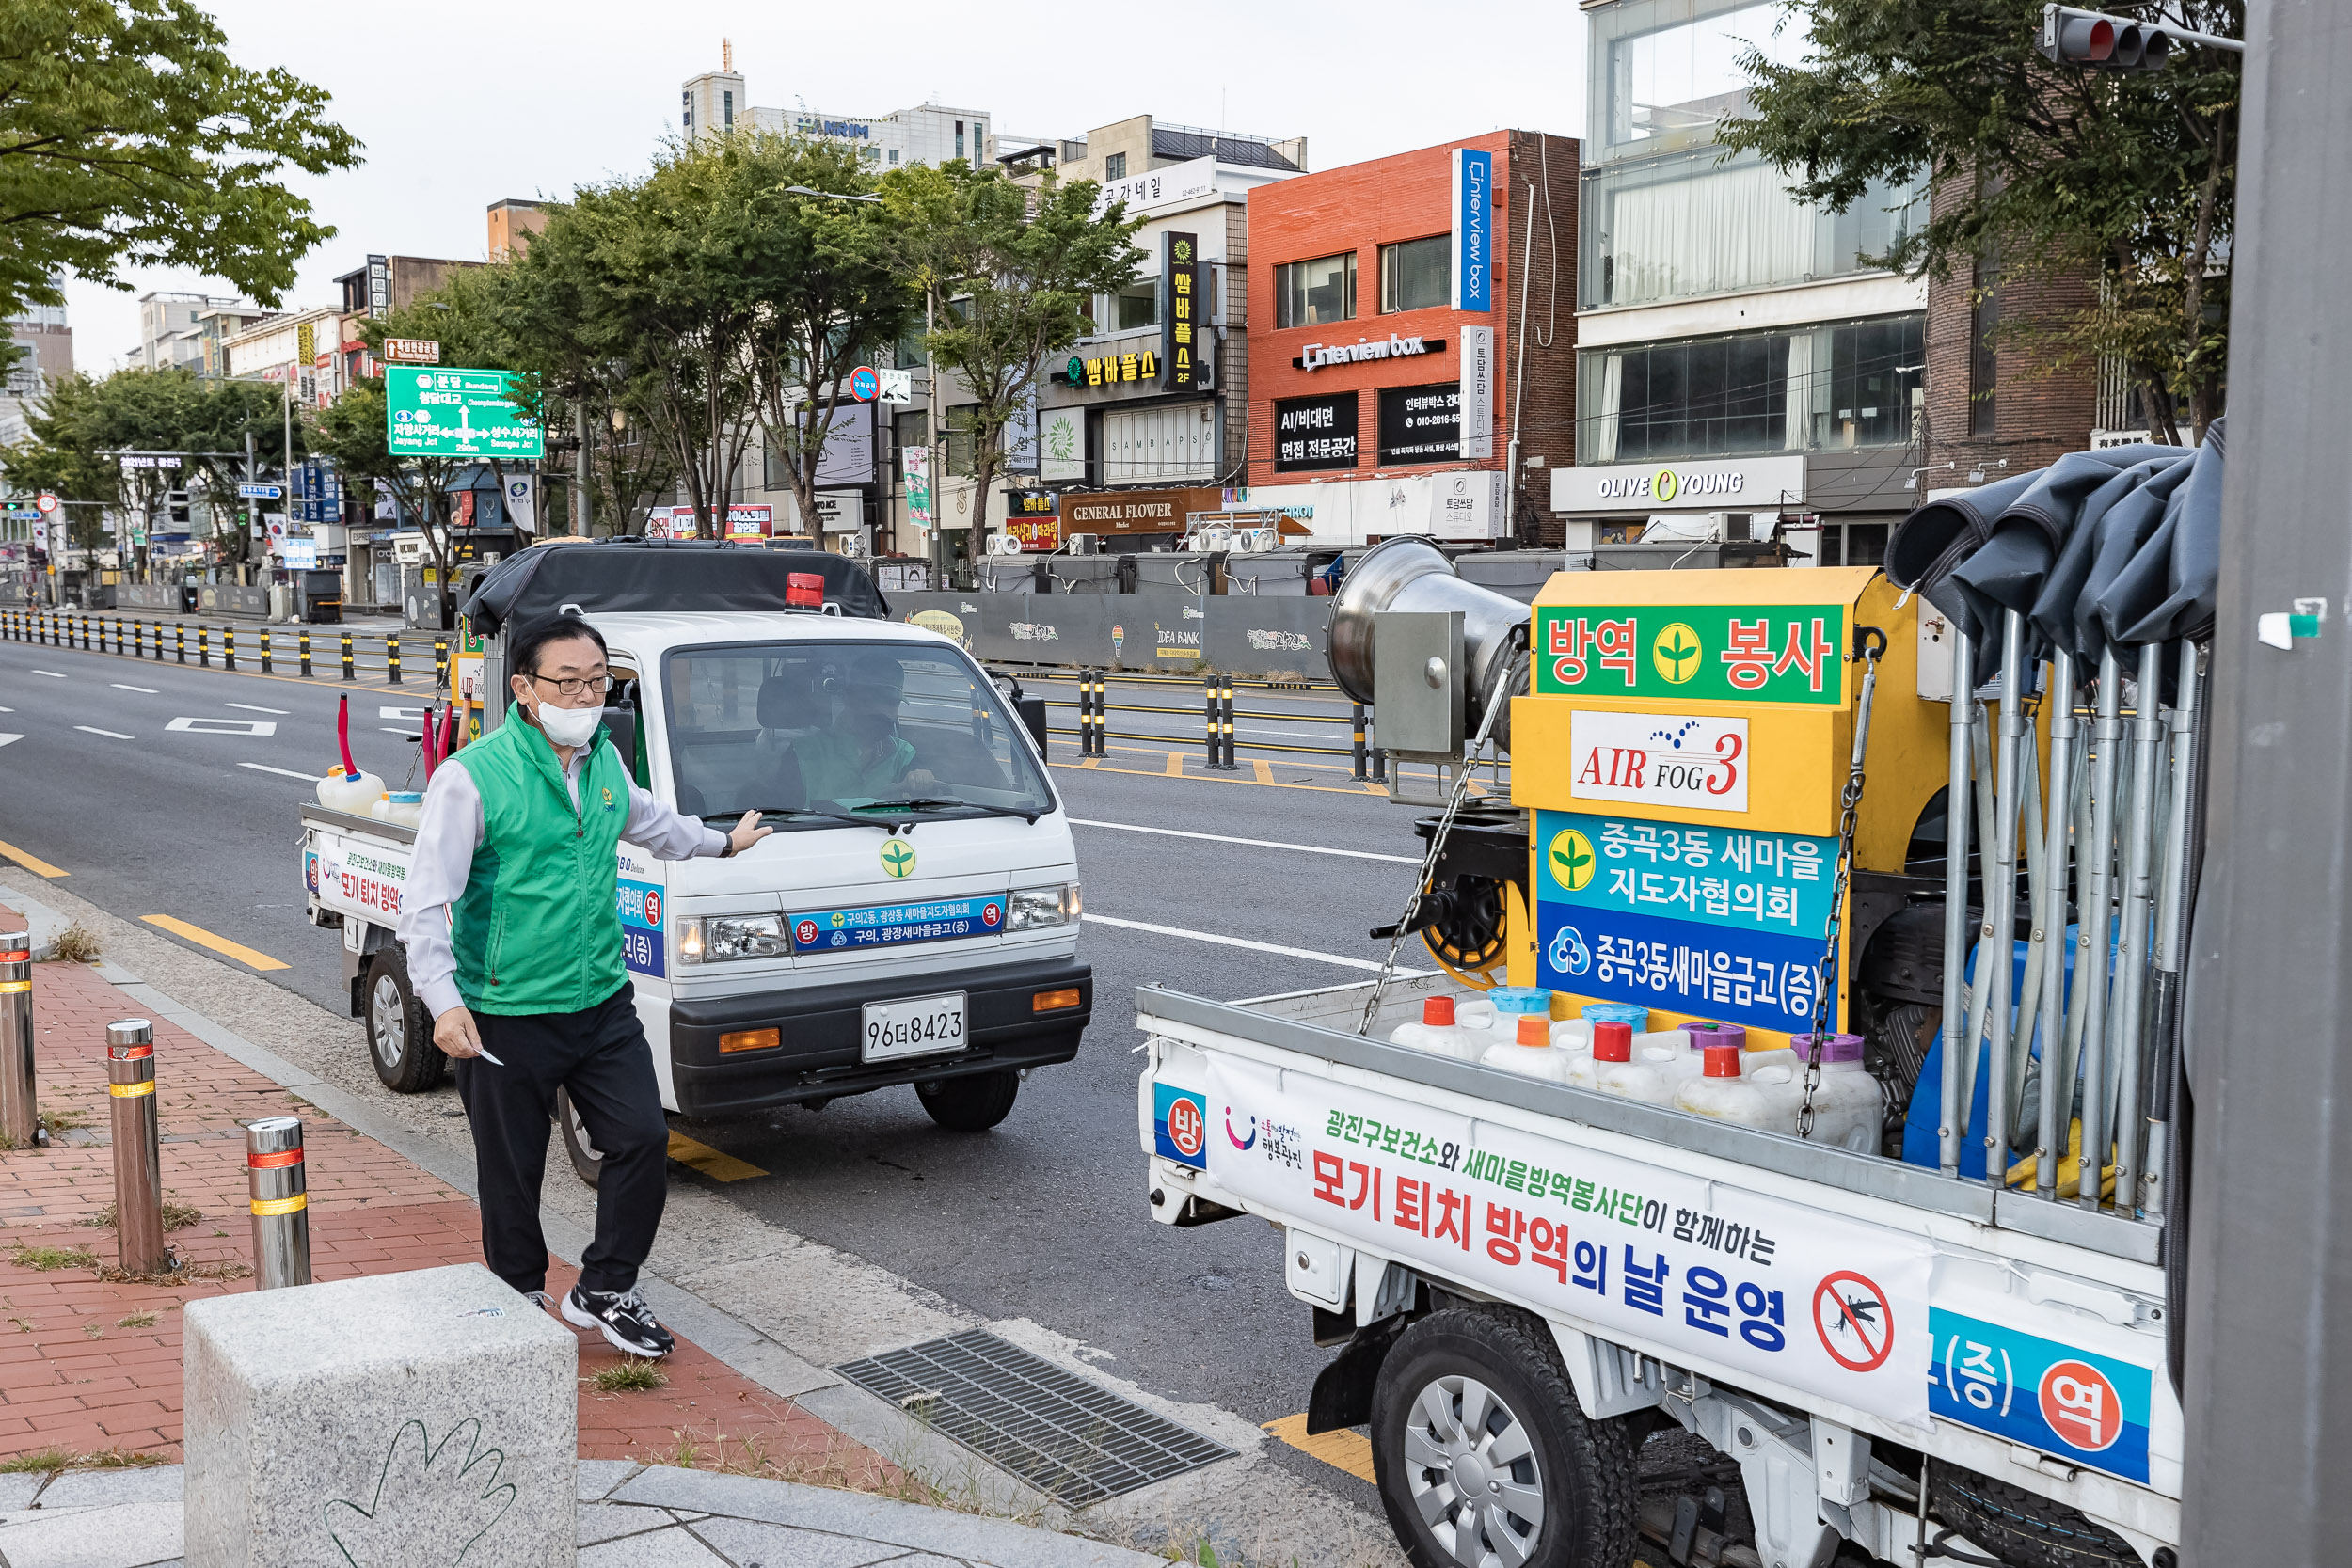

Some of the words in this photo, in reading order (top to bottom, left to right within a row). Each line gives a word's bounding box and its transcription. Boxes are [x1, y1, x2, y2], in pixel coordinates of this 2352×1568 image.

[798, 118, 868, 139] HANRIM
[1470, 173, 1484, 261] interview
[1470, 265, 1484, 300] box
[1175, 273, 1192, 369] 쌈바플스
[1304, 337, 1390, 371] interview
[1391, 333, 1426, 357] box
[1087, 351, 1155, 386] 쌈바플스
[1177, 373, 1190, 383] 2F
[437, 375, 461, 388] 분당
[465, 382, 499, 391] Bundang
[419, 391, 462, 405] 청담대교
[1406, 395, 1445, 411] 인터뷰박스
[393, 423, 440, 436] 자양사거리
[490, 426, 538, 439] 성수사거리
[1281, 407, 1334, 432] AI/비대면
[1476, 397, 1486, 442] 스튜디오
[393, 437, 423, 447] Jayang
[424, 437, 437, 446] Jct
[455, 444, 479, 452] 290m
[491, 439, 519, 450] Seongsu
[522, 440, 533, 449] Jct
[1281, 440, 1304, 462] 면접
[1308, 436, 1356, 458] 전문공간
[1598, 477, 1650, 498] OLIVE
[1678, 472, 1743, 494] YOUNG
[1073, 505, 1123, 521] GENERAL
[1126, 503, 1173, 519] FLOWER
[1446, 512, 1473, 522] 스튜디오
[1157, 630, 1175, 644] IDEA
[1177, 631, 1200, 645] BANK
[1548, 617, 1638, 688] 방역
[1720, 617, 1833, 694] 봉사
[1578, 746, 1647, 790] AIR
[1655, 764, 1704, 792] FOG
[1706, 733, 1743, 796] 3
[1600, 822, 1714, 869] 중곡3동
[1719, 833, 1824, 882] 새마을
[377, 861, 406, 881] 새마을방역봉
[631, 863, 645, 875] Deluxe
[342, 872, 358, 903] 모기
[361, 878, 379, 909] 퇴치
[1608, 868, 1799, 927] 지도자협의회
[647, 896, 659, 922] 역
[847, 912, 879, 927] 구의2동,
[880, 909, 904, 923] 광장동
[904, 902, 970, 920] 새마을지도자협의회
[985, 907, 996, 922] 역
[800, 925, 814, 939] 방
[854, 928, 880, 943] 구의,
[882, 921, 970, 941] 광장새마을금고(증)
[1596, 935, 1822, 1019] 중곡3동새마을금고(증)
[867, 1010, 962, 1051] 96더8423
[1174, 1104, 1201, 1149] 방
[1263, 1138, 1302, 1170] 행복광진
[1327, 1109, 1460, 1173] 광진구보건소와
[1462, 1143, 1662, 1232] 새마을방역봉사단이
[1674, 1208, 1775, 1267] 함께하는
[1312, 1149, 1381, 1223] 모기
[1394, 1174, 1471, 1251] 퇴치
[1486, 1201, 1606, 1295] 방역의
[1623, 1244, 1669, 1317] 날
[1682, 1265, 1786, 1353] 운영
[2052, 1374, 2103, 1446] 역
